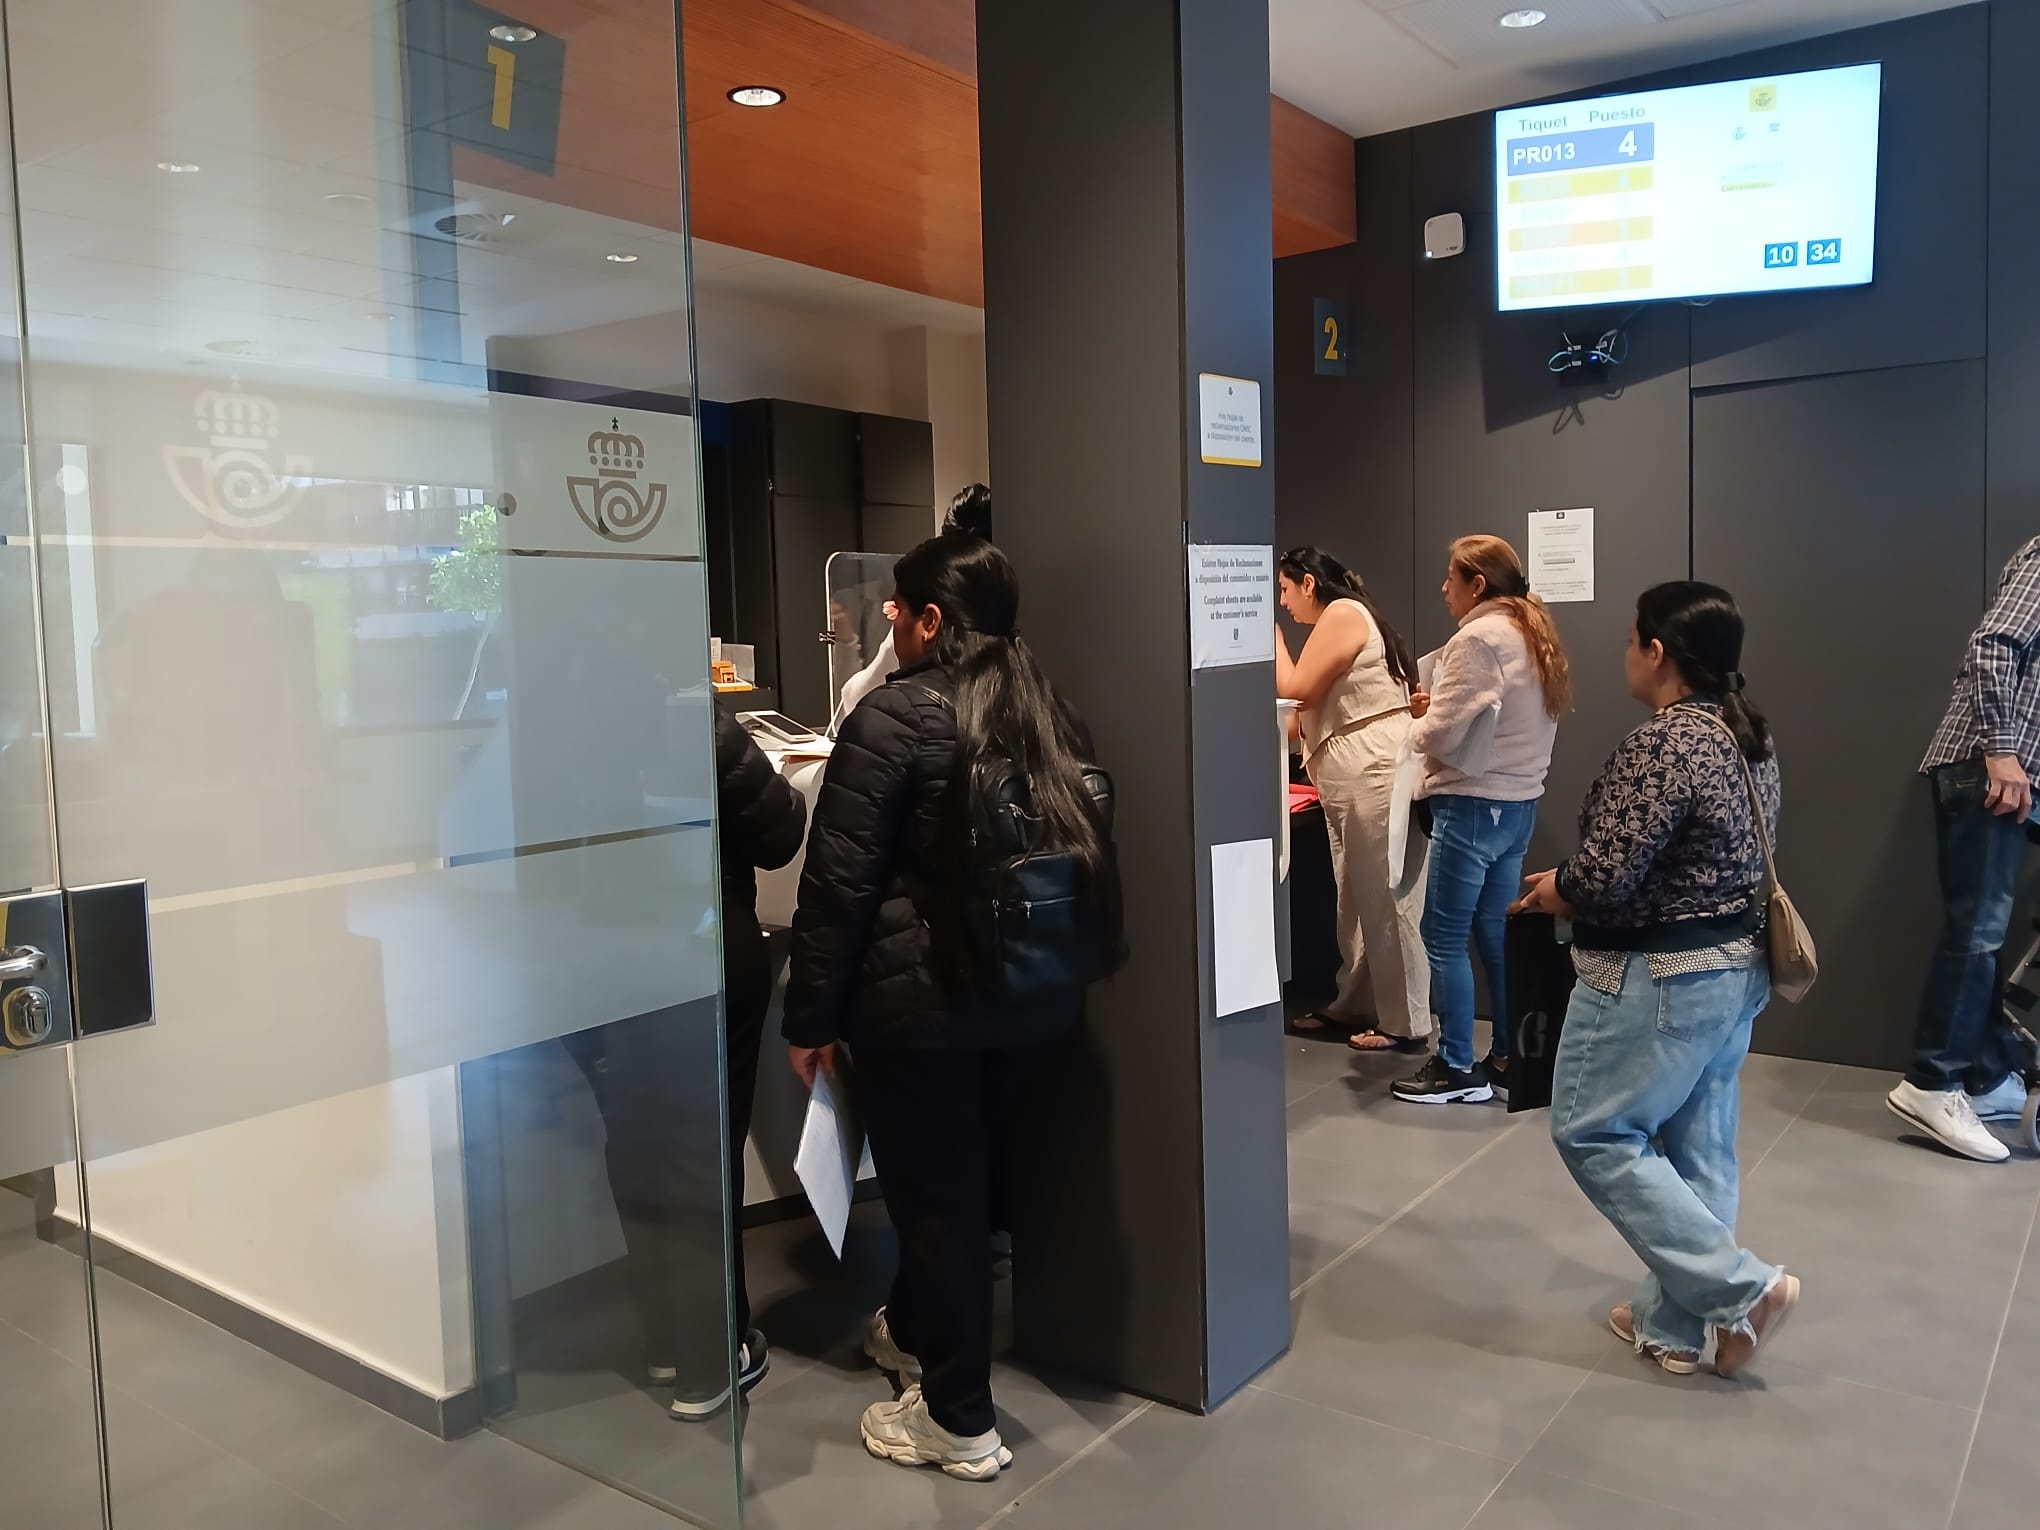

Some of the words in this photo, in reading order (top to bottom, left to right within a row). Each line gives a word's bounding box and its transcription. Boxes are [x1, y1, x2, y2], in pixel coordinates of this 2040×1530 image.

[487, 44, 516, 131] 1
[1518, 115, 1568, 133] Tiquet
[1589, 106, 1646, 124] Puesto
[1512, 141, 1577, 167] PR013
[1617, 129, 1638, 158] 4
[1767, 244, 1795, 265] 10
[1810, 241, 1838, 262] 34
[1324, 317, 1339, 360] 2
